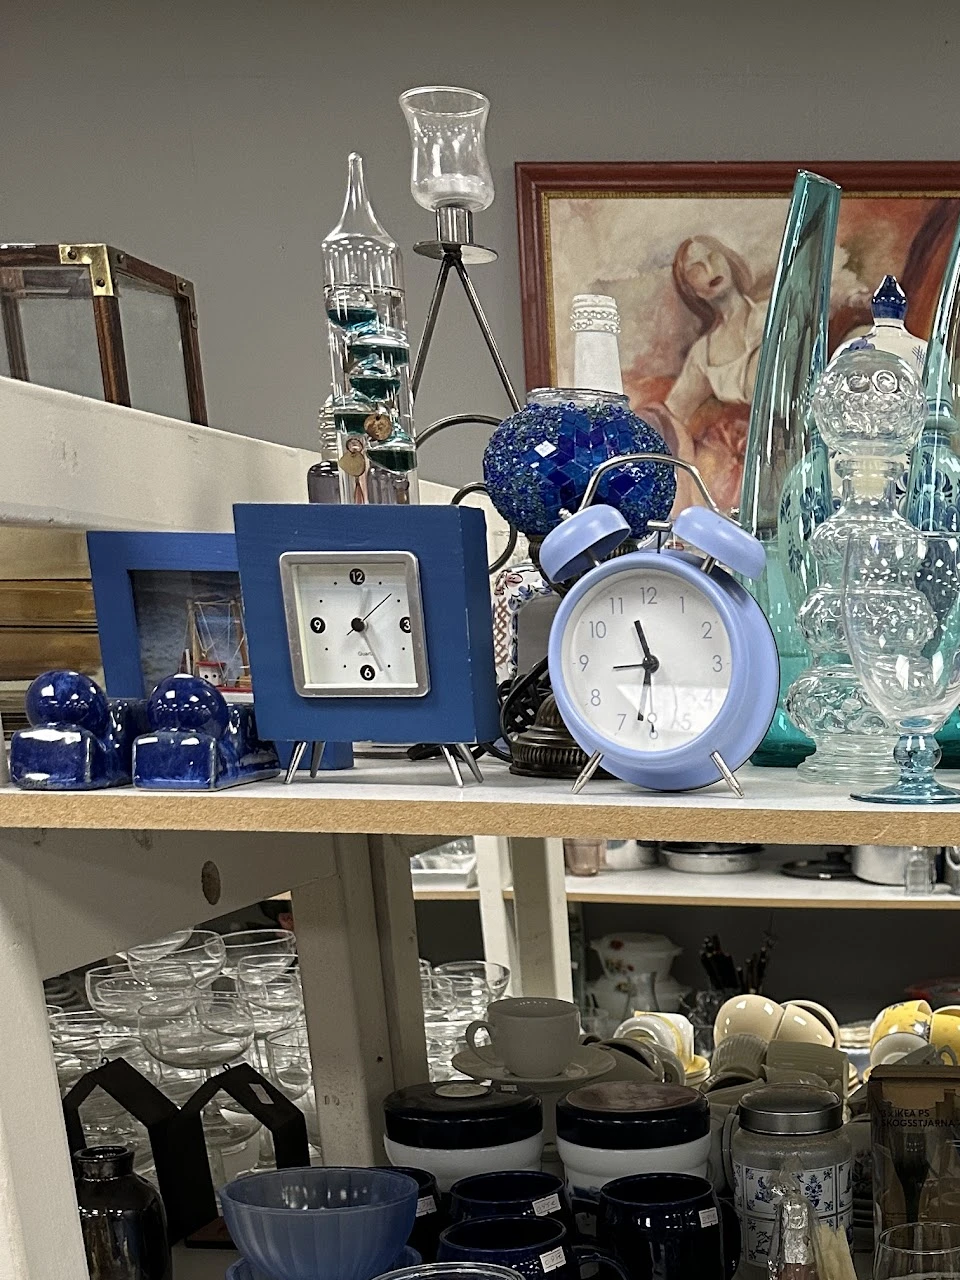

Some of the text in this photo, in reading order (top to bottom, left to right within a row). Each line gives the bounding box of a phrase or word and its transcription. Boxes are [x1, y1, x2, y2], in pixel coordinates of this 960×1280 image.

[352, 571, 363, 582] 12
[640, 587, 658, 605] 12
[679, 596, 685, 614] 1
[610, 597, 624, 615] 11
[589, 621, 607, 639] 10
[701, 621, 713, 639] 2
[579, 655, 589, 672] 9
[712, 655, 723, 672] 3
[590, 688, 601, 706] 8
[617, 713, 627, 731] 7
